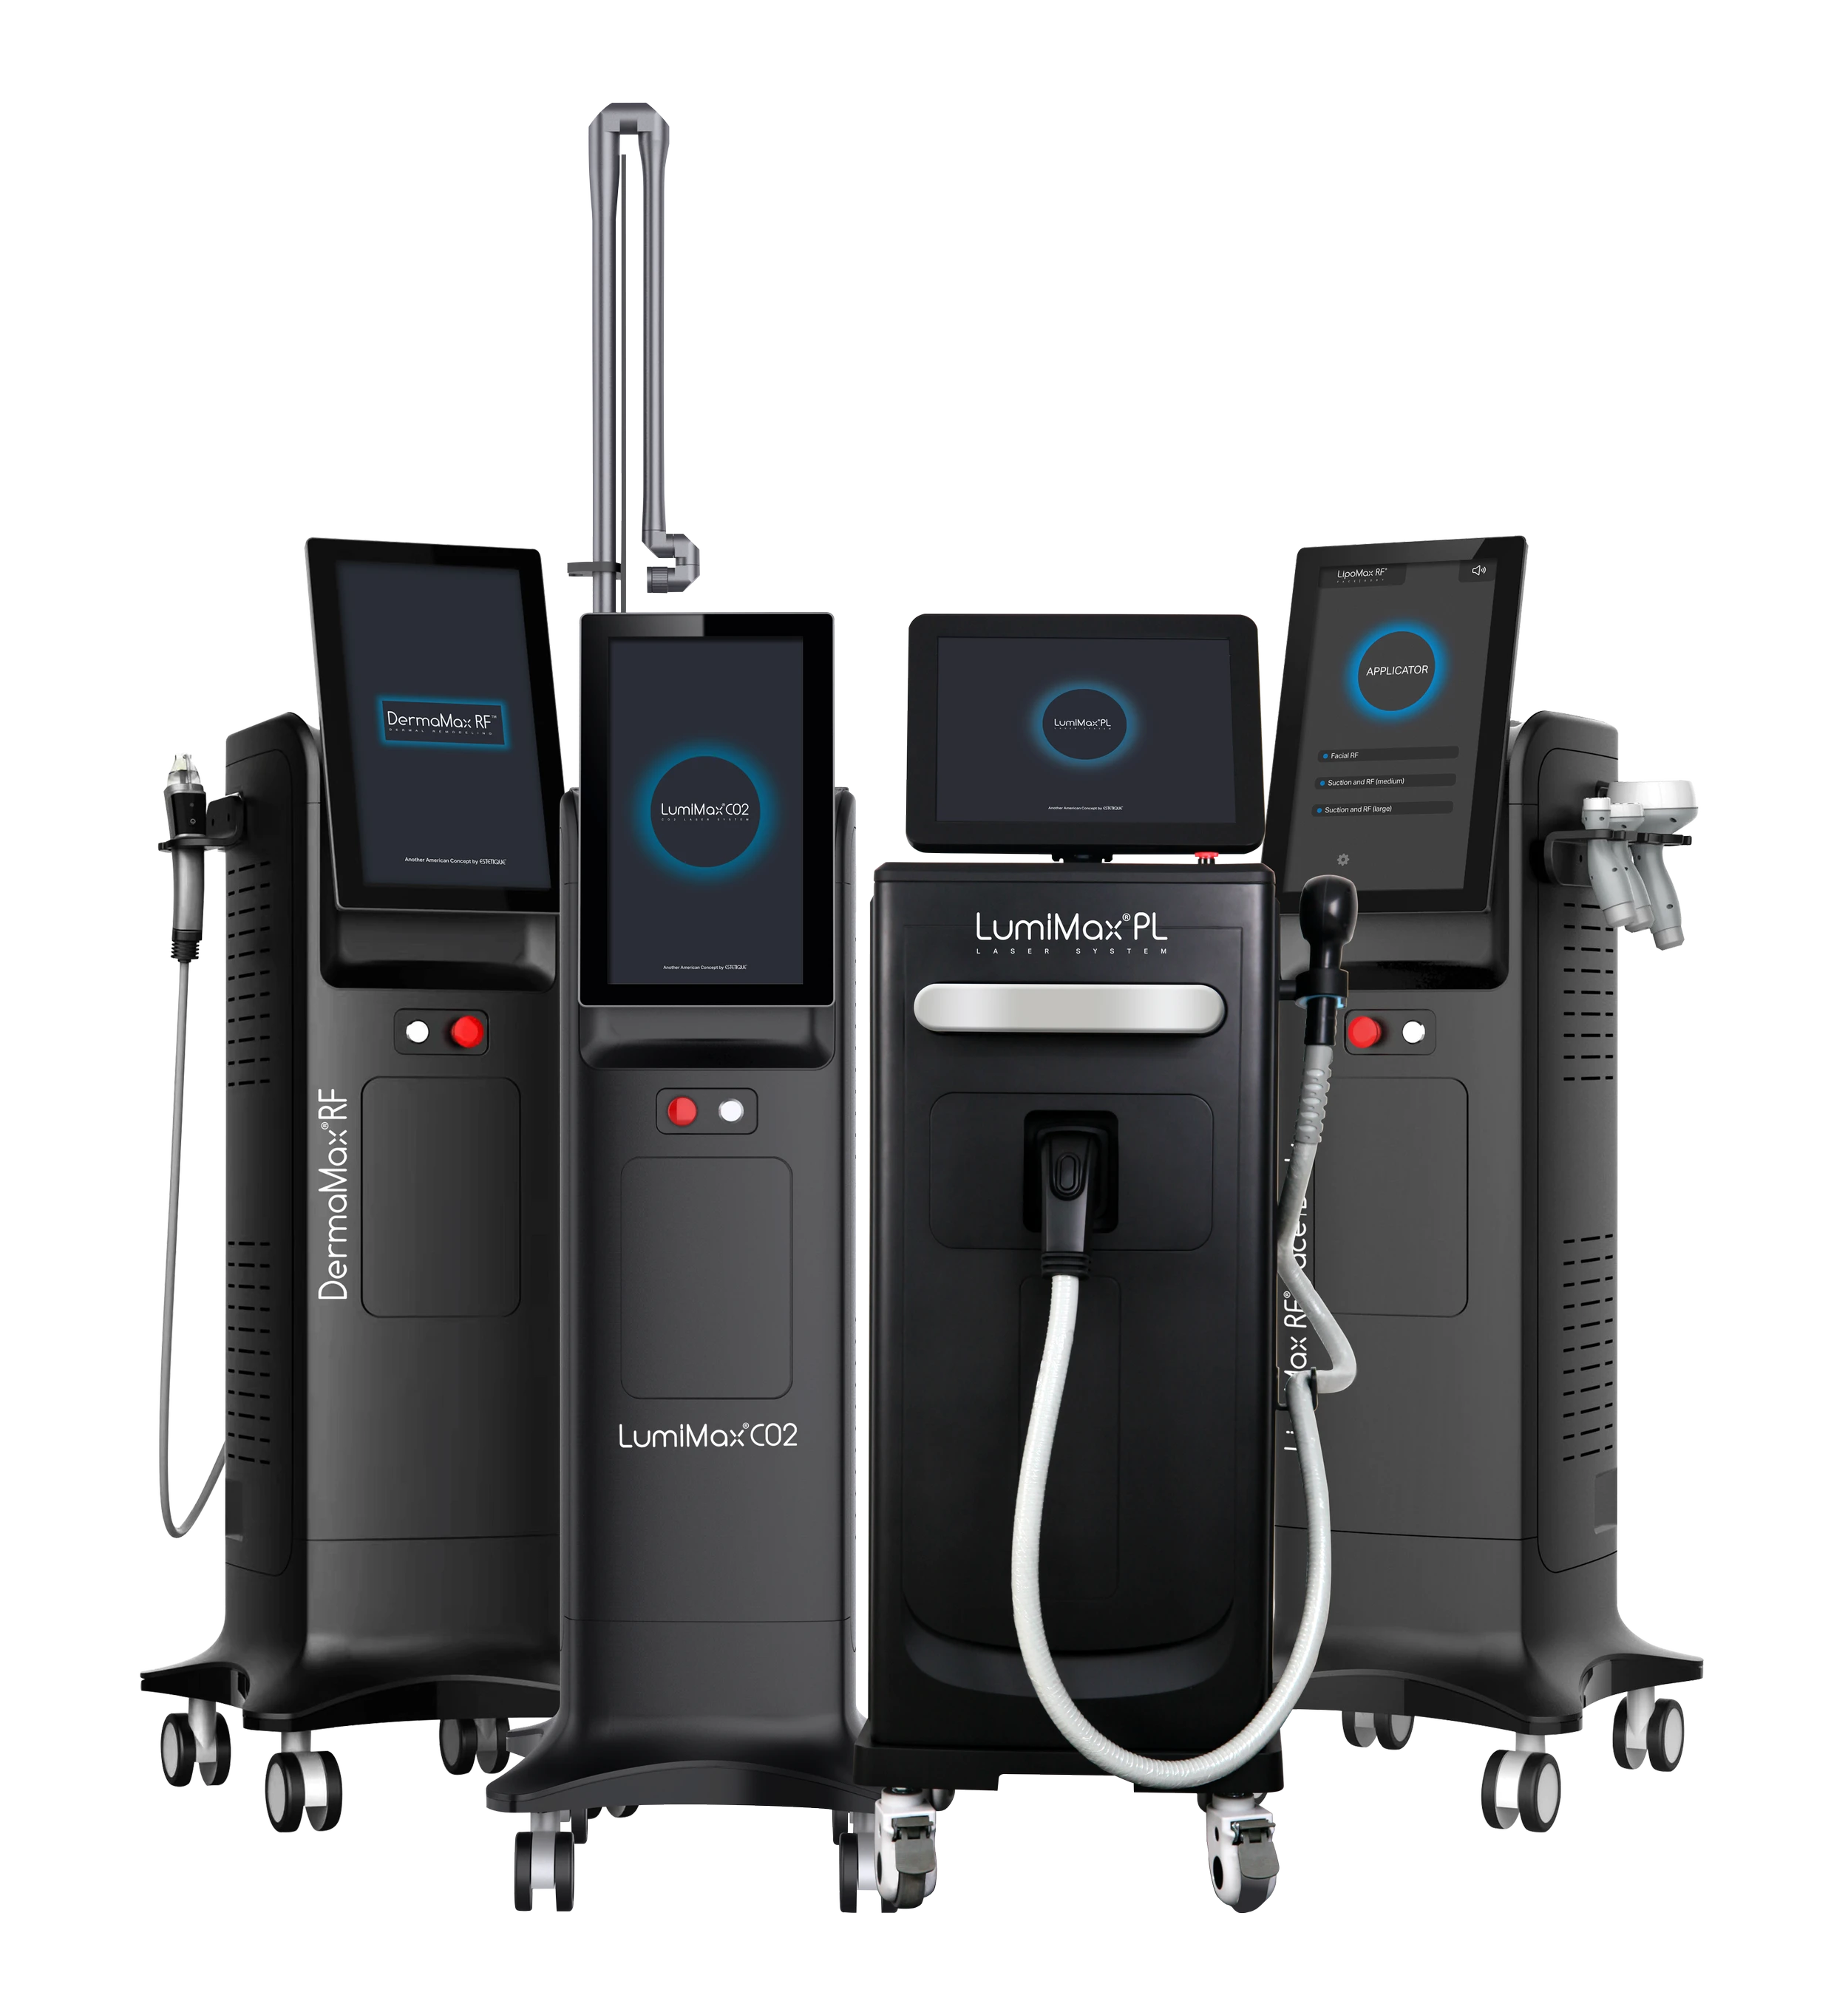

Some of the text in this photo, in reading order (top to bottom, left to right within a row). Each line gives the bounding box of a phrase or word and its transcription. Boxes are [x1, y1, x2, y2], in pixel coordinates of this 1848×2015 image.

[1337, 568, 1374, 580] LipoMax
[1365, 665, 1429, 676] APPLICATOR
[387, 710, 472, 729] DermaMax
[1375, 778, 1405, 786] (medium)
[1372, 805, 1393, 813] (large)
